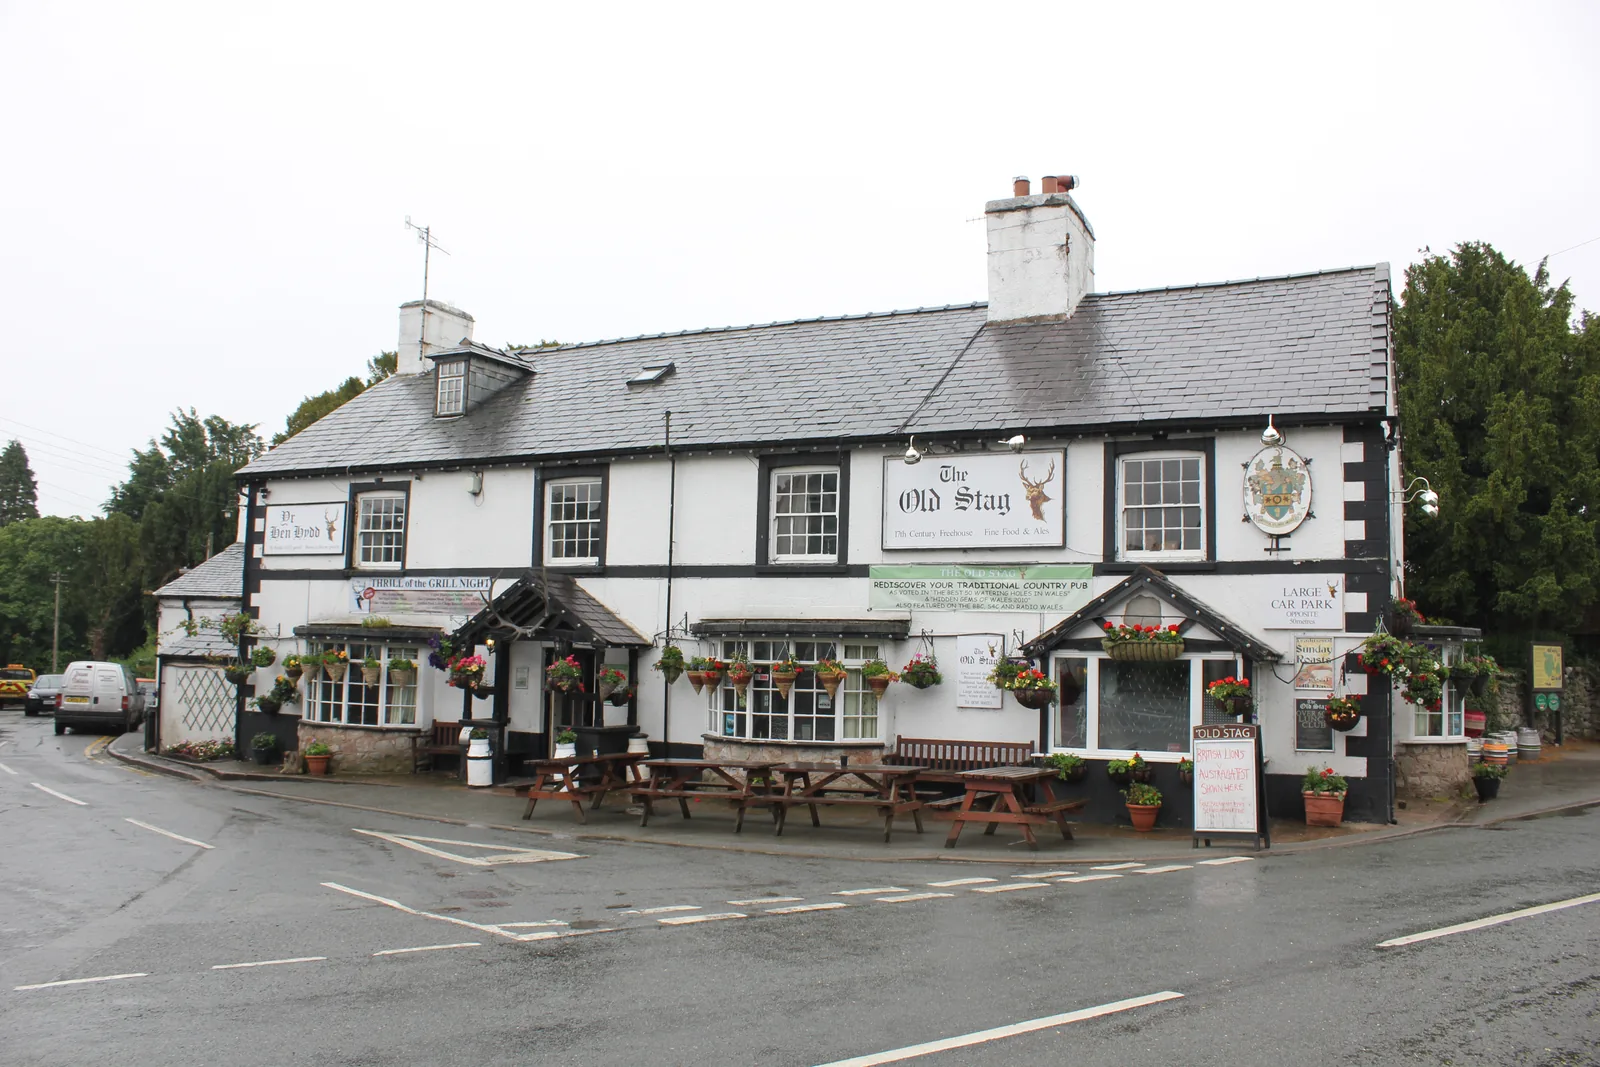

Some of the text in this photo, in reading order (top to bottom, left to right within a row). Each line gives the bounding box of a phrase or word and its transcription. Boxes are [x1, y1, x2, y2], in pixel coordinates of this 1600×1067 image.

[940, 465, 968, 483] The
[899, 486, 1010, 516] Old Stag
[294, 526, 320, 539] Hydd
[909, 530, 936, 539] Century
[984, 528, 999, 536] Fine
[1002, 528, 1020, 536] Food
[1033, 527, 1050, 535] Ales
[942, 569, 960, 577] THE
[372, 579, 404, 588] THRILL
[405, 579, 413, 588] of
[414, 579, 426, 588] the
[428, 579, 457, 588] GRILL
[460, 579, 489, 588] NIGHT
[1283, 588, 1322, 597] LARGE
[1271, 600, 1333, 609] CAR PARK
[1296, 644, 1332, 654] Sunday
[960, 656, 975, 665] Old
[1296, 655, 1332, 664] Roasts
[1223, 728, 1250, 738] STAG
[1224, 748, 1246, 760] LIONS
[1224, 783, 1244, 792] HERE
